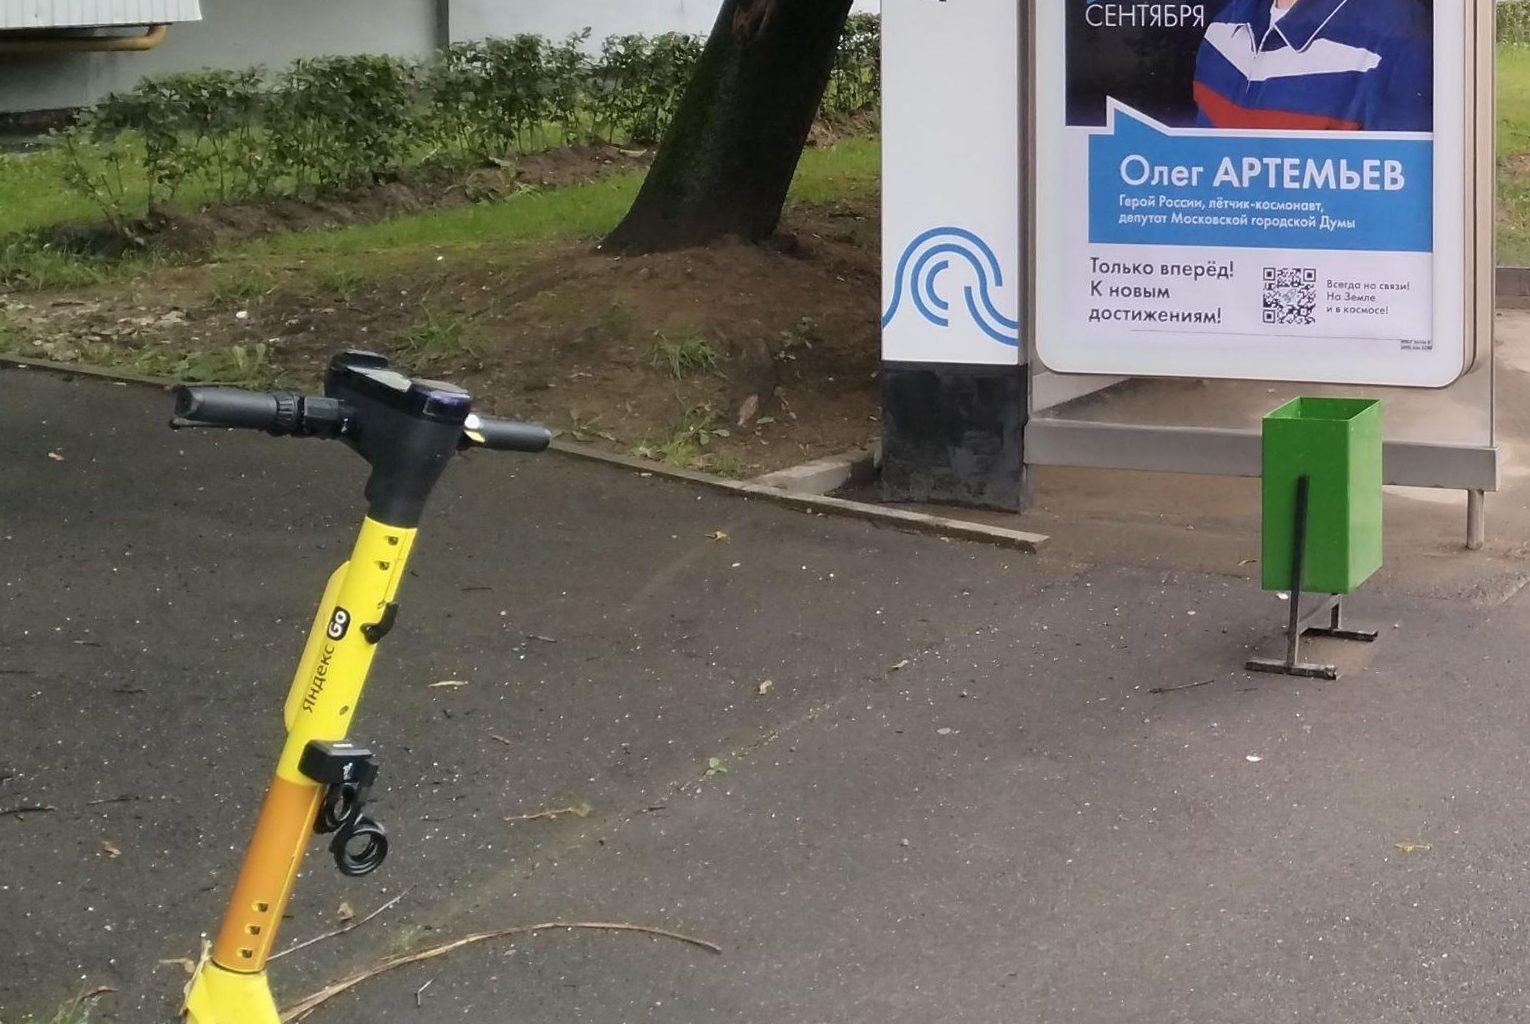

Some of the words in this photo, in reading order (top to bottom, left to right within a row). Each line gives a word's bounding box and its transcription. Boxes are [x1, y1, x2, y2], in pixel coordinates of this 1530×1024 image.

[1085, 4, 1205, 28] СЕНТЯБРЯ
[1120, 154, 1202, 188] Олег
[1213, 156, 1406, 191] АРТЕМЬЕВ
[1119, 194, 1156, 210] Герой
[1159, 196, 1206, 210] России,
[1209, 198, 1324, 213] лётчик-космонавт,
[1119, 213, 1167, 225] депутат
[1171, 213, 1249, 226] Московской
[1251, 216, 1317, 230] городской
[1320, 216, 1356, 231] Думы
[1090, 257, 1154, 276] Только
[1160, 259, 1234, 281] вперёд!
[1091, 282, 1103, 298] К
[1109, 286, 1170, 299] новым
[1326, 279, 1361, 290] Всегда
[1363, 282, 1376, 290] на
[1379, 282, 1410, 291] связи!
[1326, 291, 1341, 301] На
[1344, 292, 1376, 302] Земле
[1089, 308, 1222, 324] достижениям!
[1343, 305, 1389, 315] космосе!
[302, 644, 335, 713] Яндекс
